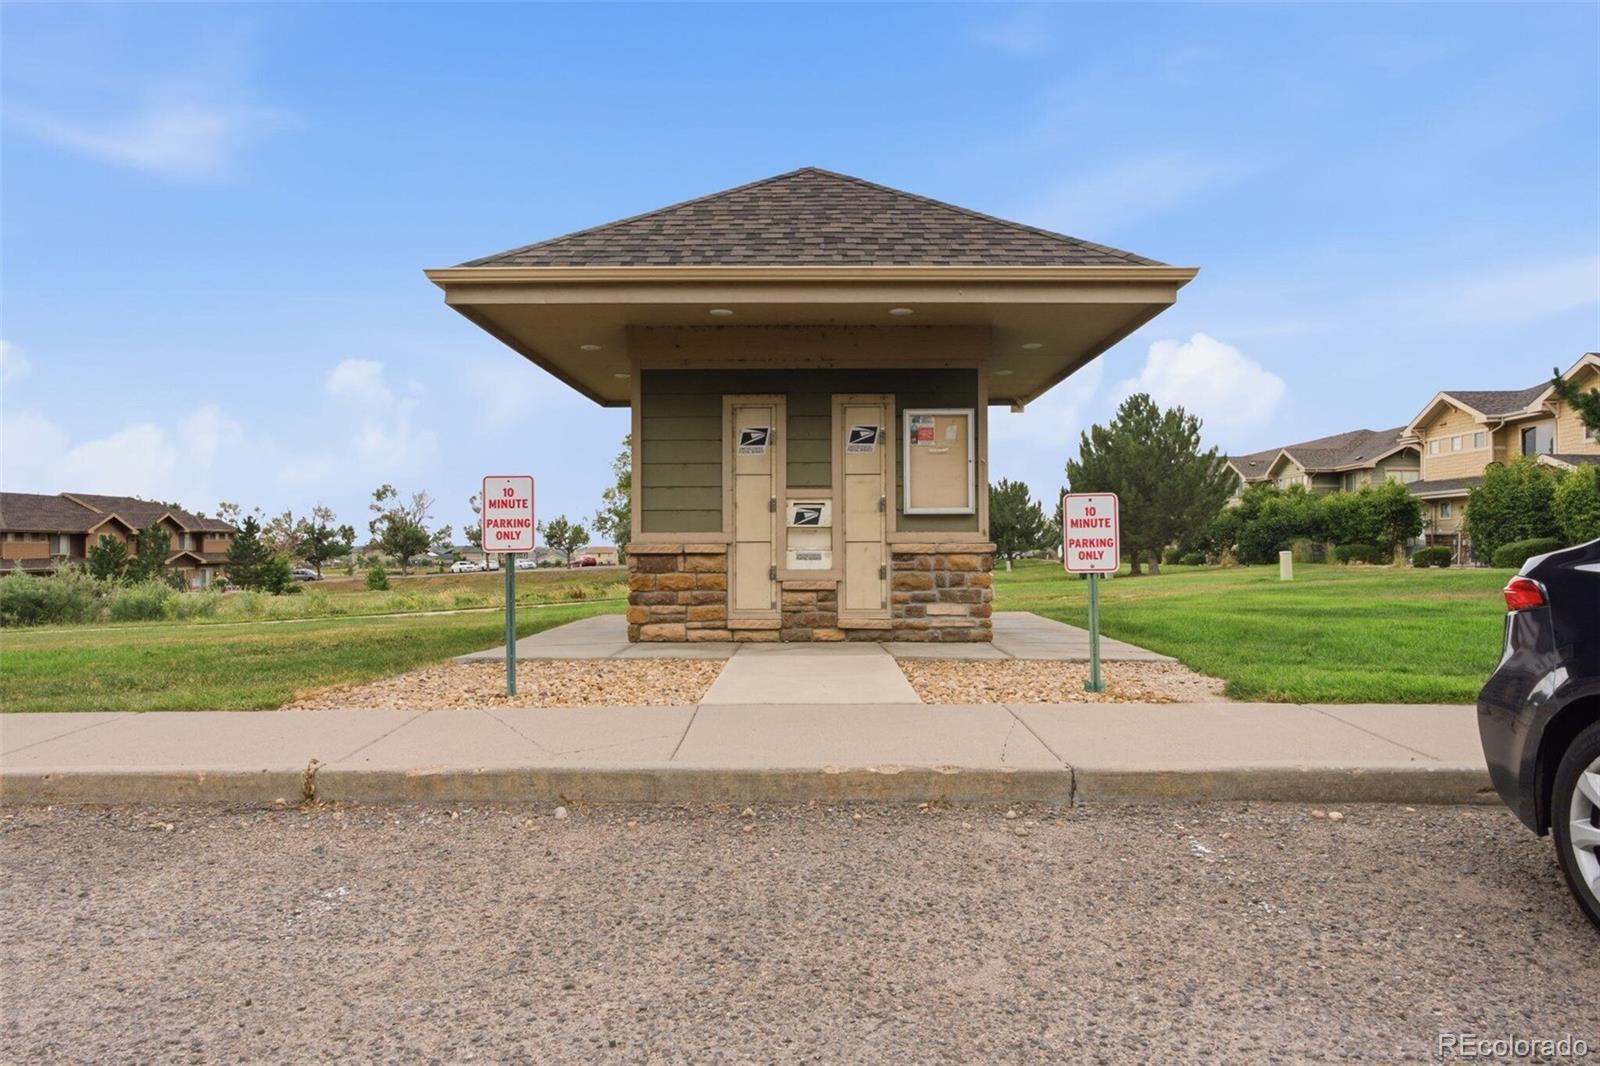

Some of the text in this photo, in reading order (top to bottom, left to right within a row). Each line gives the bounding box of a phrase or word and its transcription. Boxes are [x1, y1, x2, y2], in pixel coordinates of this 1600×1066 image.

[503, 488, 514, 497] 10
[488, 499, 528, 509] MINUTE
[1085, 507, 1096, 516] 10
[486, 519, 531, 528] PARKING
[1070, 518, 1111, 528] MINUTE
[496, 531, 521, 540] ONLY
[1068, 538, 1114, 548] PARKING
[1078, 551, 1104, 560] ONLY
